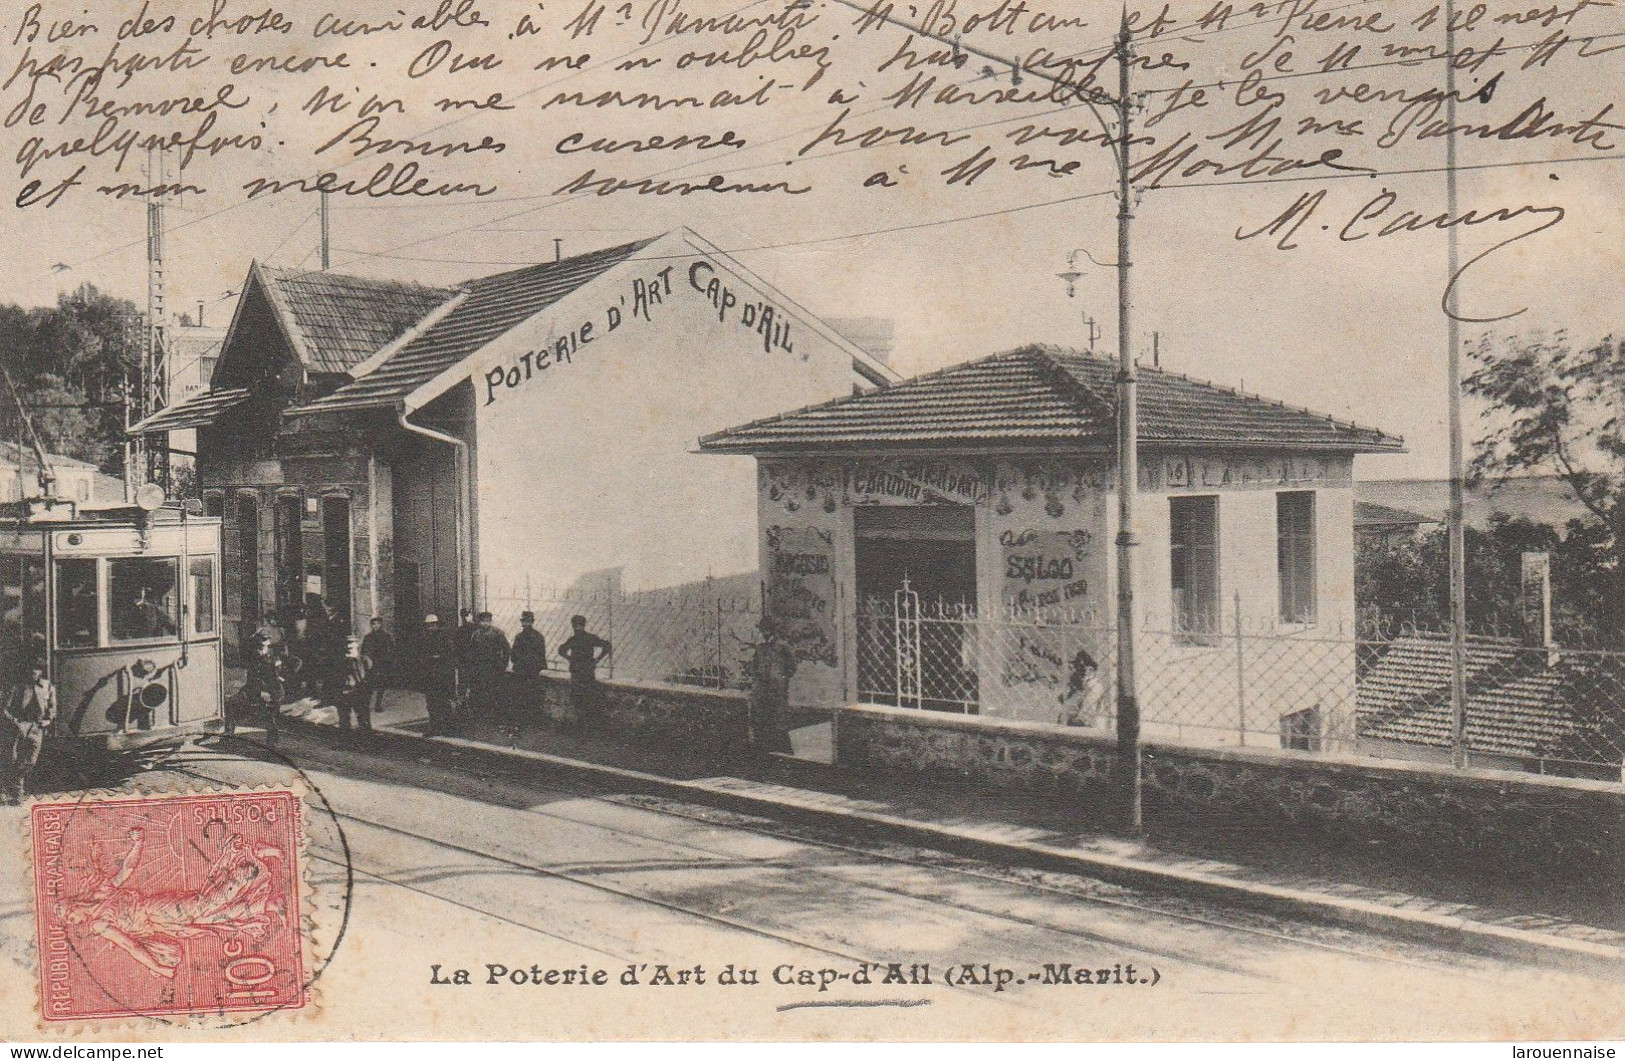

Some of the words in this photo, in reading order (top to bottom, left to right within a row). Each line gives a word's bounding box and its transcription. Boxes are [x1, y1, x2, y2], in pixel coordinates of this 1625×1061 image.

[13, 3, 98, 45] Bien
[117, 1, 176, 40] des
[189, 0, 293, 39] choses
[688, 260, 736, 323] CAP
